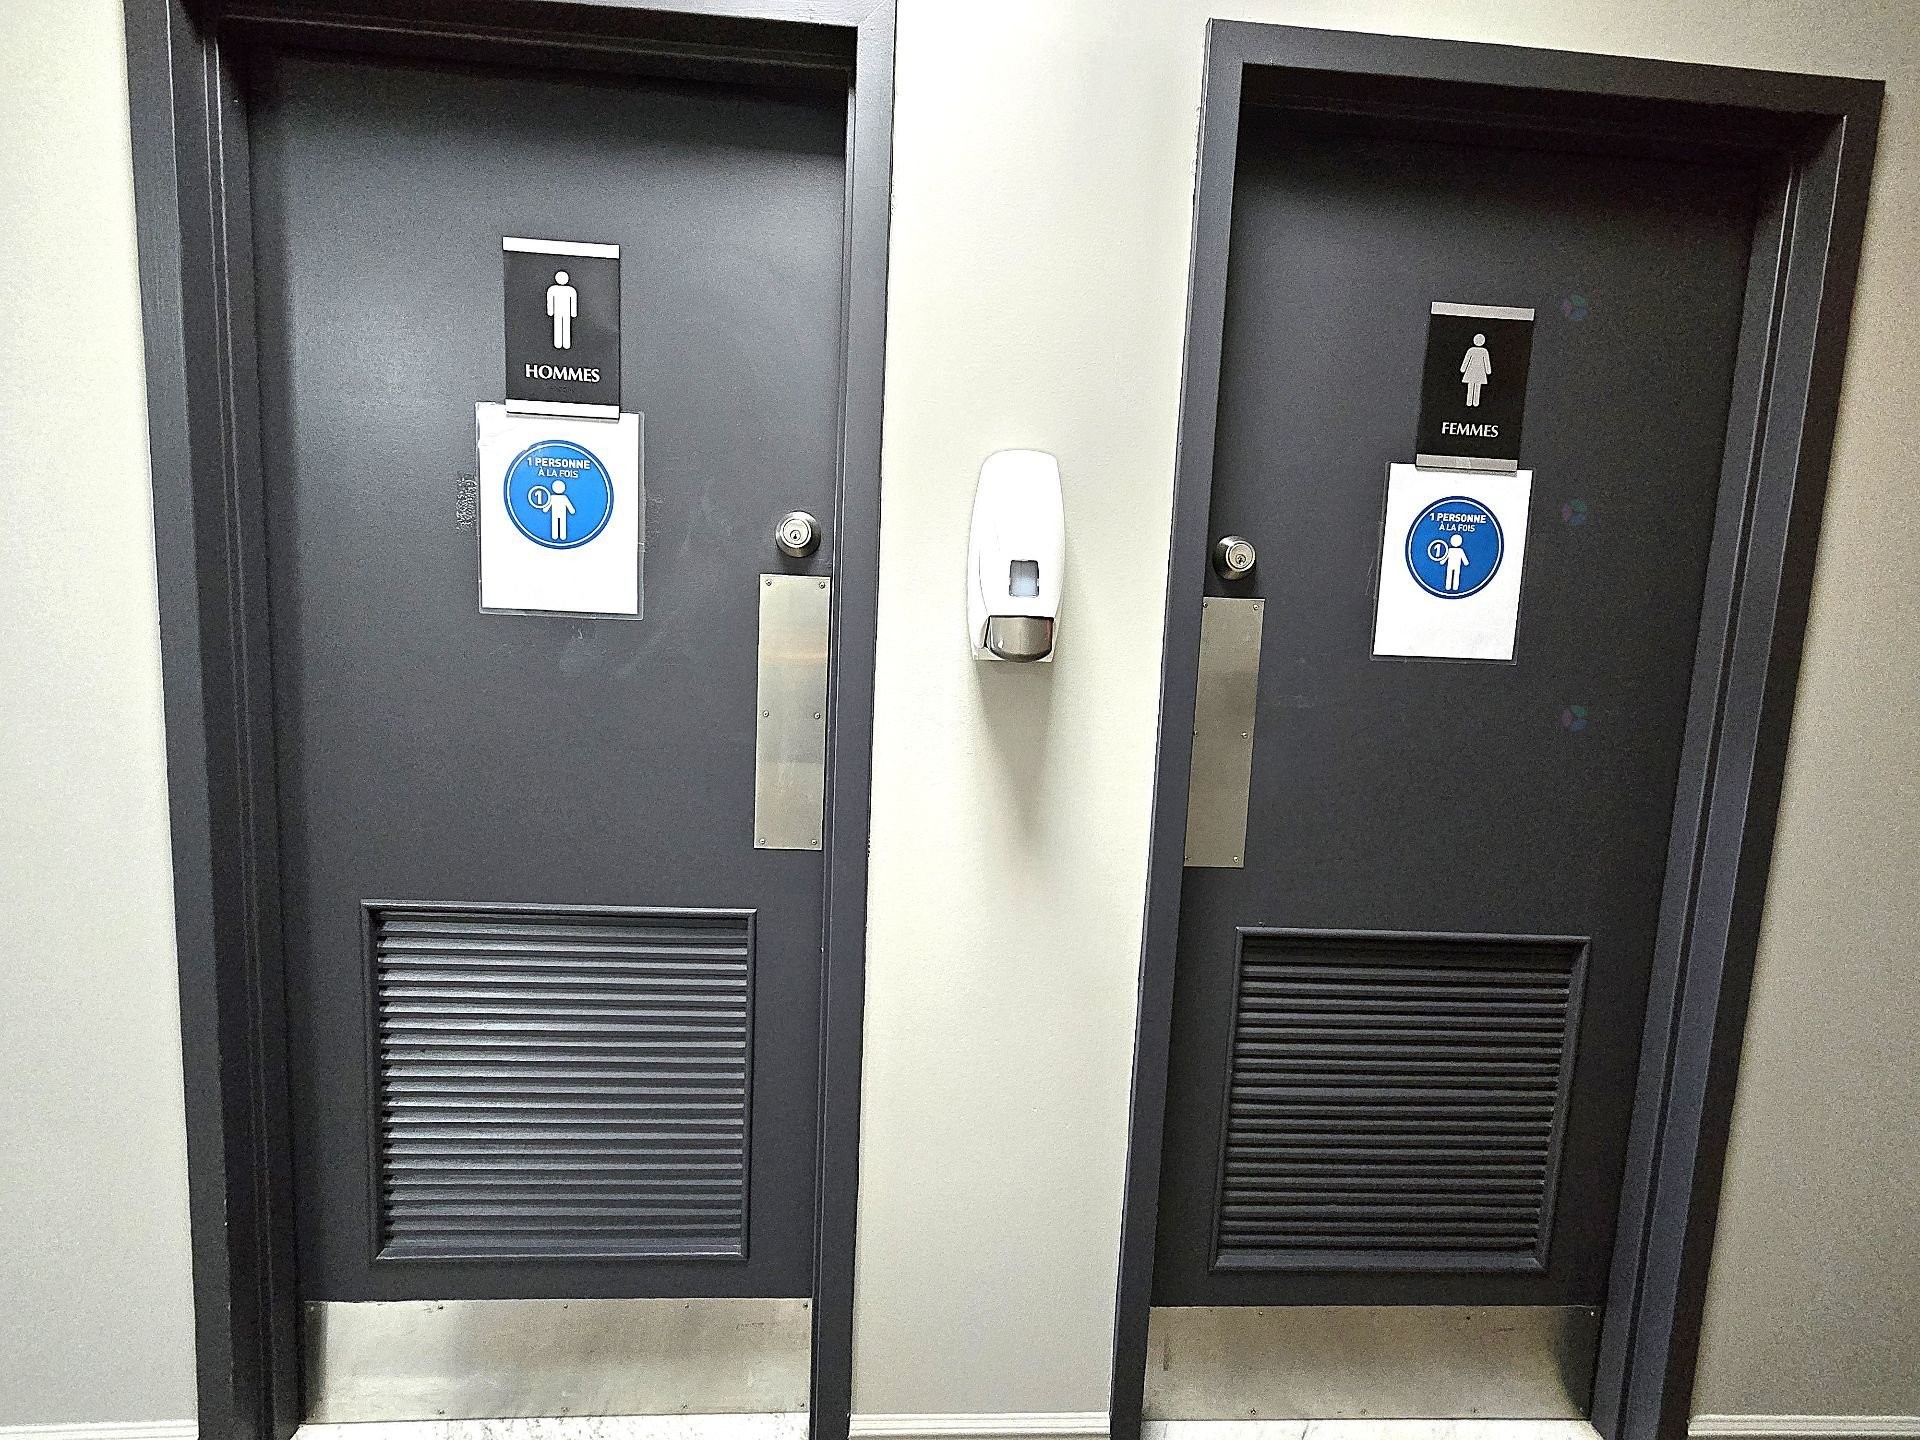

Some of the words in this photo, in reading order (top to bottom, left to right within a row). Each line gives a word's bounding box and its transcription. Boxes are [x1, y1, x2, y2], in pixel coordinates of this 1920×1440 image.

[525, 363, 600, 382] HOMMES
[1441, 421, 1499, 438] FEMMES
[527, 457, 532, 466] 1
[535, 457, 591, 469] PERSONNE
[538, 467, 545, 476] À
[546, 469, 557, 477] LA
[559, 469, 579, 478] FOIS
[534, 490, 542, 504] 1
[1436, 513, 1487, 523] PERSONNE
[1439, 521, 1445, 531] À
[1457, 524, 1476, 532] FOIS
[1433, 543, 1441, 557] 1
